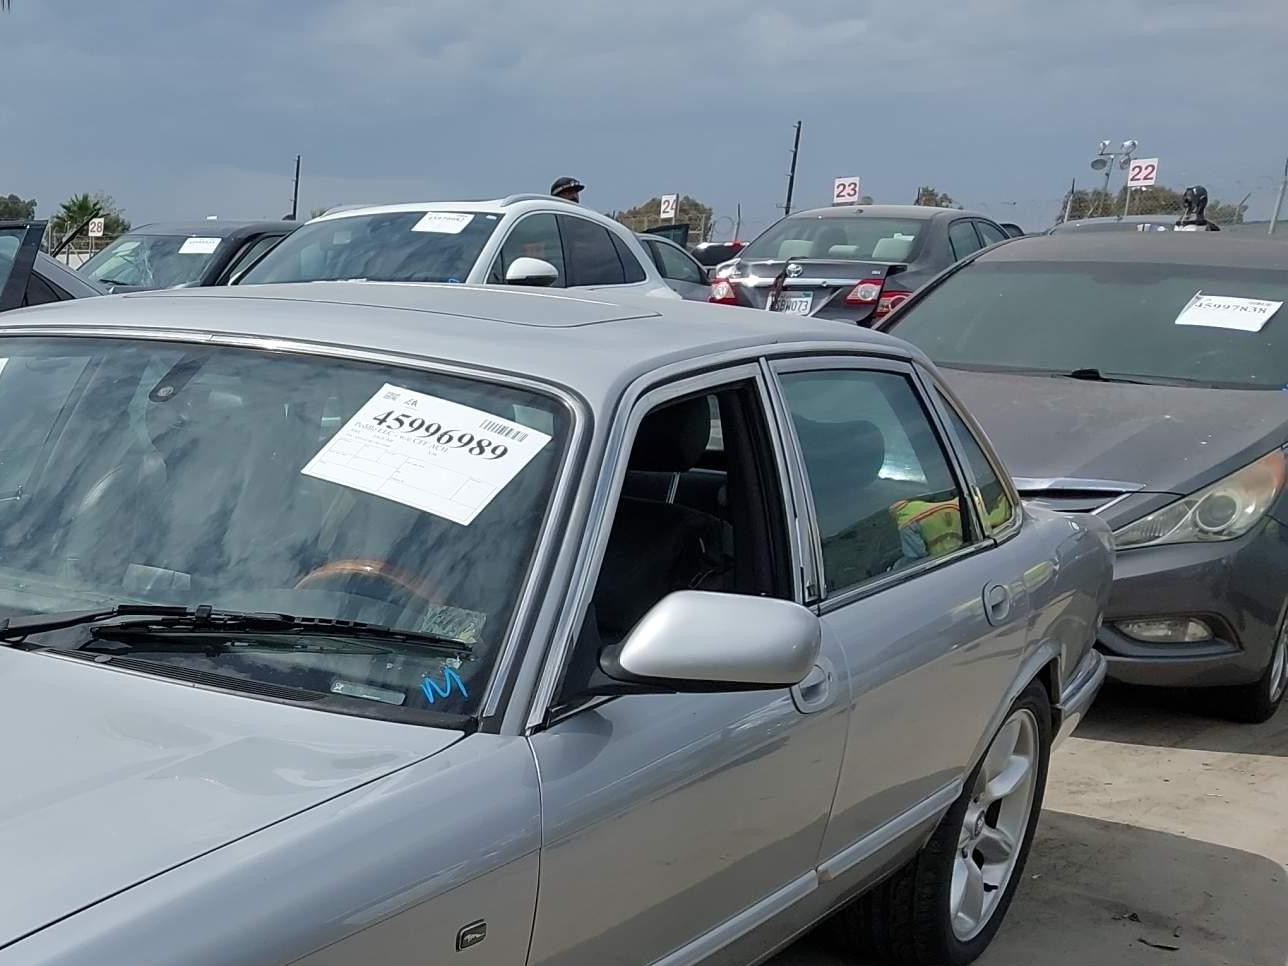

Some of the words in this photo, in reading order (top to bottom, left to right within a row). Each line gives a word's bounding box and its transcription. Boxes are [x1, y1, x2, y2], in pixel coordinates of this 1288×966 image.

[1130, 164, 1155, 181] 22
[836, 182, 857, 198] 23
[90, 221, 103, 233] 28
[372, 410, 509, 460] 45996989
